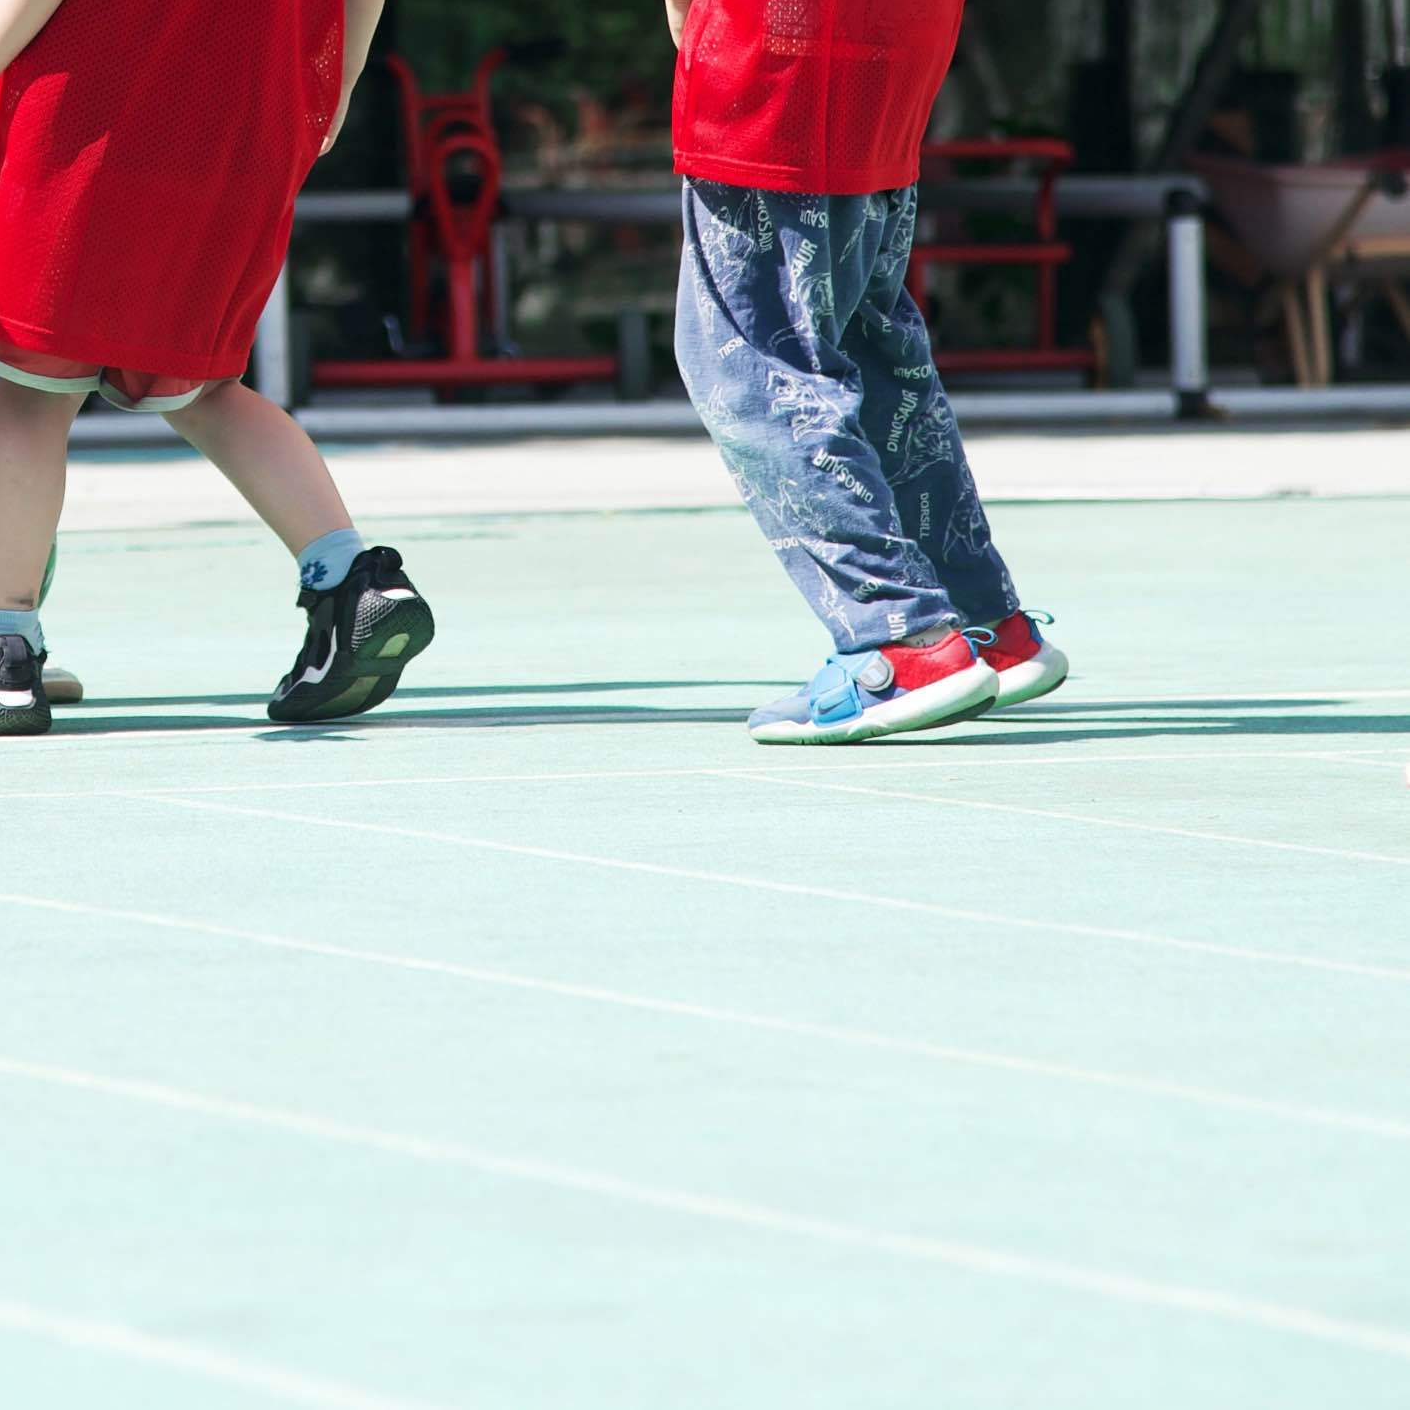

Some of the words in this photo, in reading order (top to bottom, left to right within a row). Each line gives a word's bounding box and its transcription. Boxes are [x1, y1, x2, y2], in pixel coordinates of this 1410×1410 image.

[886, 389, 919, 453] DINOSAUR
[812, 447, 874, 504] DINOSAUR
[919, 492, 931, 540] DORSILL
